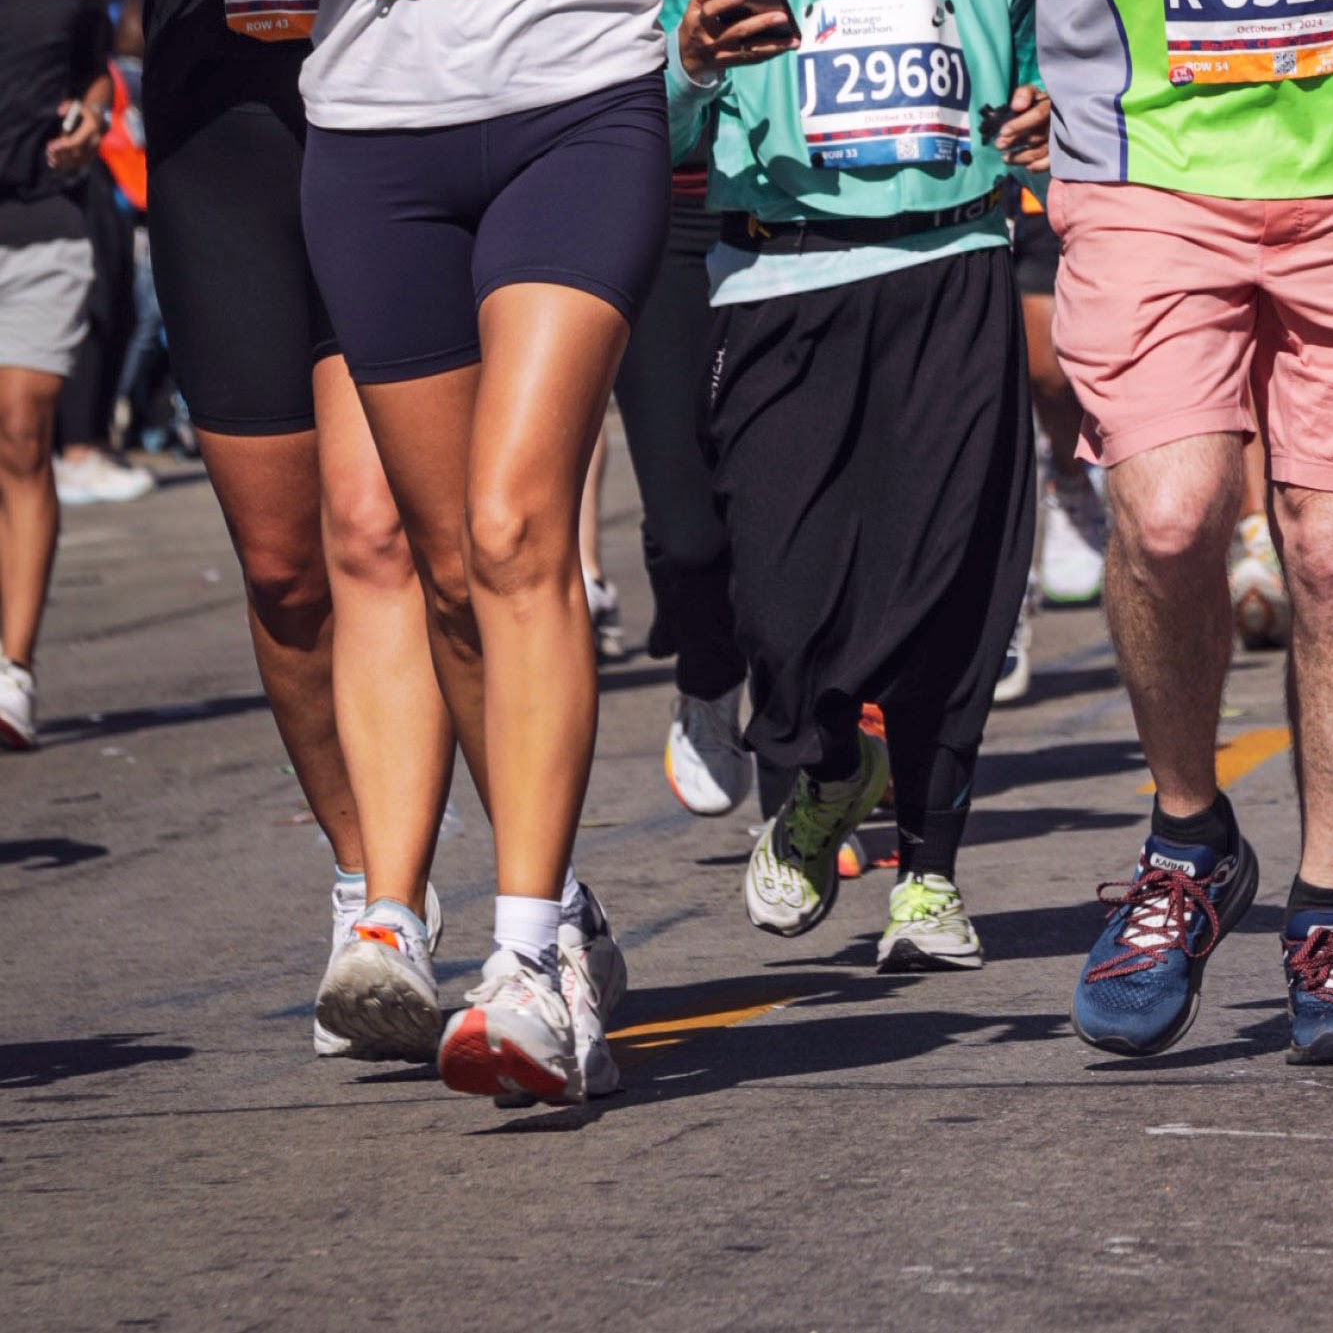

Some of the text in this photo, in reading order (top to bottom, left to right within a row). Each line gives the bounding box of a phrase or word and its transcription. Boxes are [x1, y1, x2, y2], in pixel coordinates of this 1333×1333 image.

[246, 19, 289, 32] ROW 43
[841, 15, 882, 28] Chicago
[1237, 23, 1277, 34] October
[1299, 18, 1323, 30] 2024
[841, 24, 893, 37] Marathon
[1214, 61, 1229, 72] 54
[800, 48, 964, 118] J 29681
